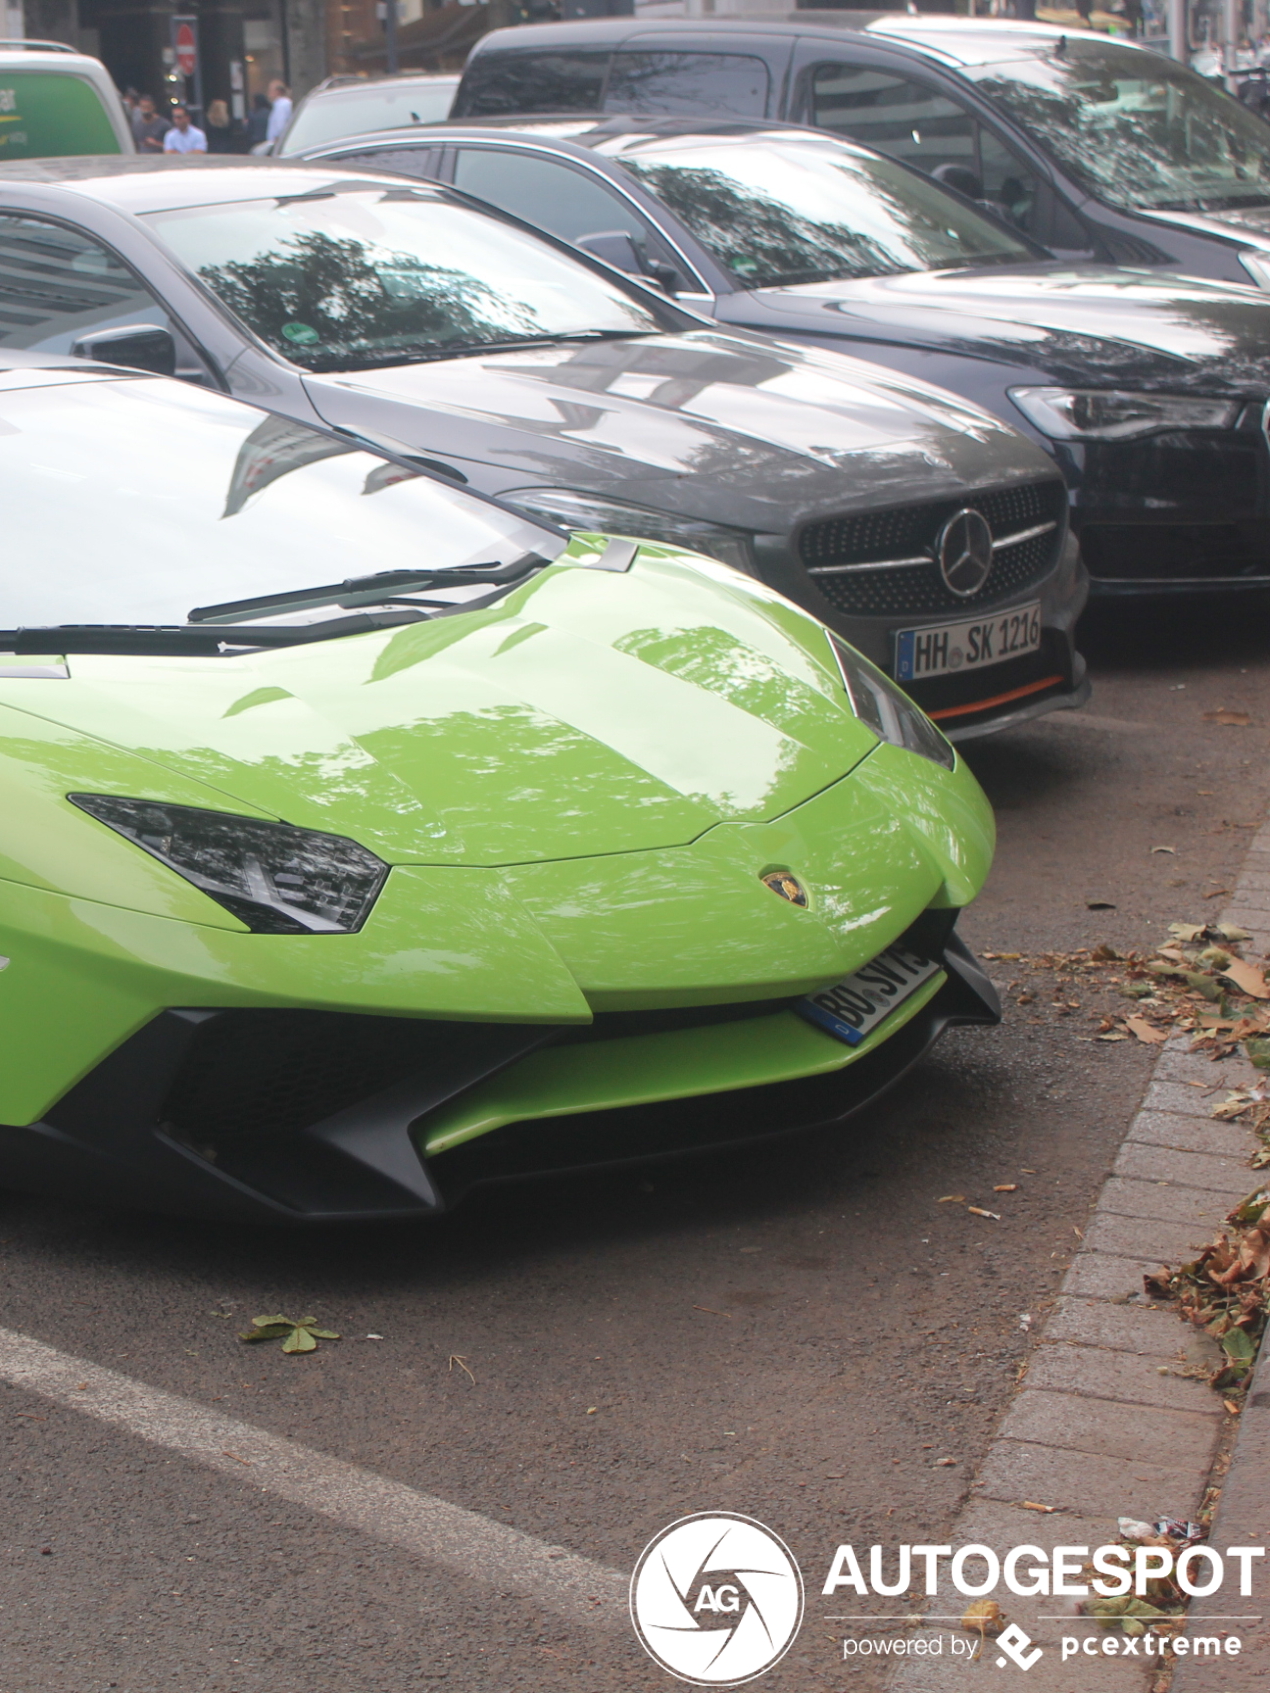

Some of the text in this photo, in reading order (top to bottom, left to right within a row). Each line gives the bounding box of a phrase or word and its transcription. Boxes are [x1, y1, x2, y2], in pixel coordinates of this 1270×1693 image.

[915, 608, 1039, 673] HH SK 1216
[812, 985, 877, 1029] BO
